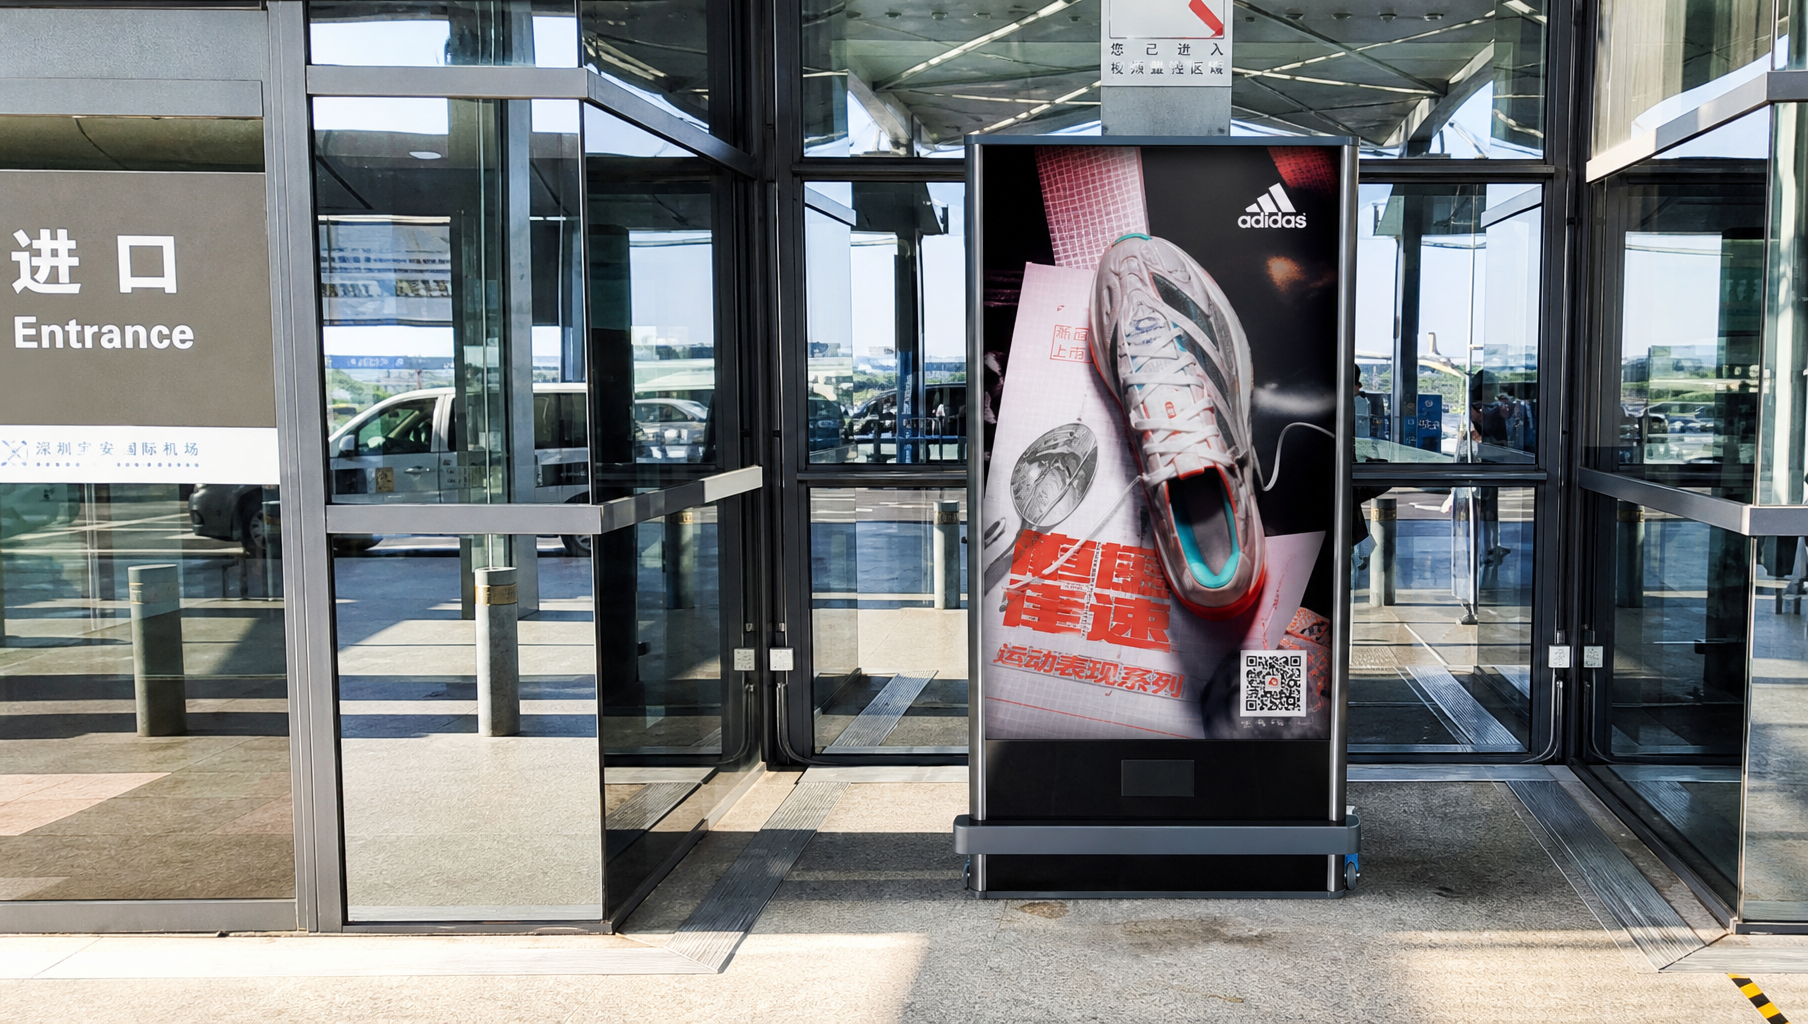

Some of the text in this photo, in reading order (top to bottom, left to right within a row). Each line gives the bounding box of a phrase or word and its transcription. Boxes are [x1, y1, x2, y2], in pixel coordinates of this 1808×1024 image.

[1237, 211, 1307, 229] adidas
[11, 228, 178, 294] 进口
[13, 315, 195, 350] Entrance
[992, 642, 1186, 698] 运动表现系列
